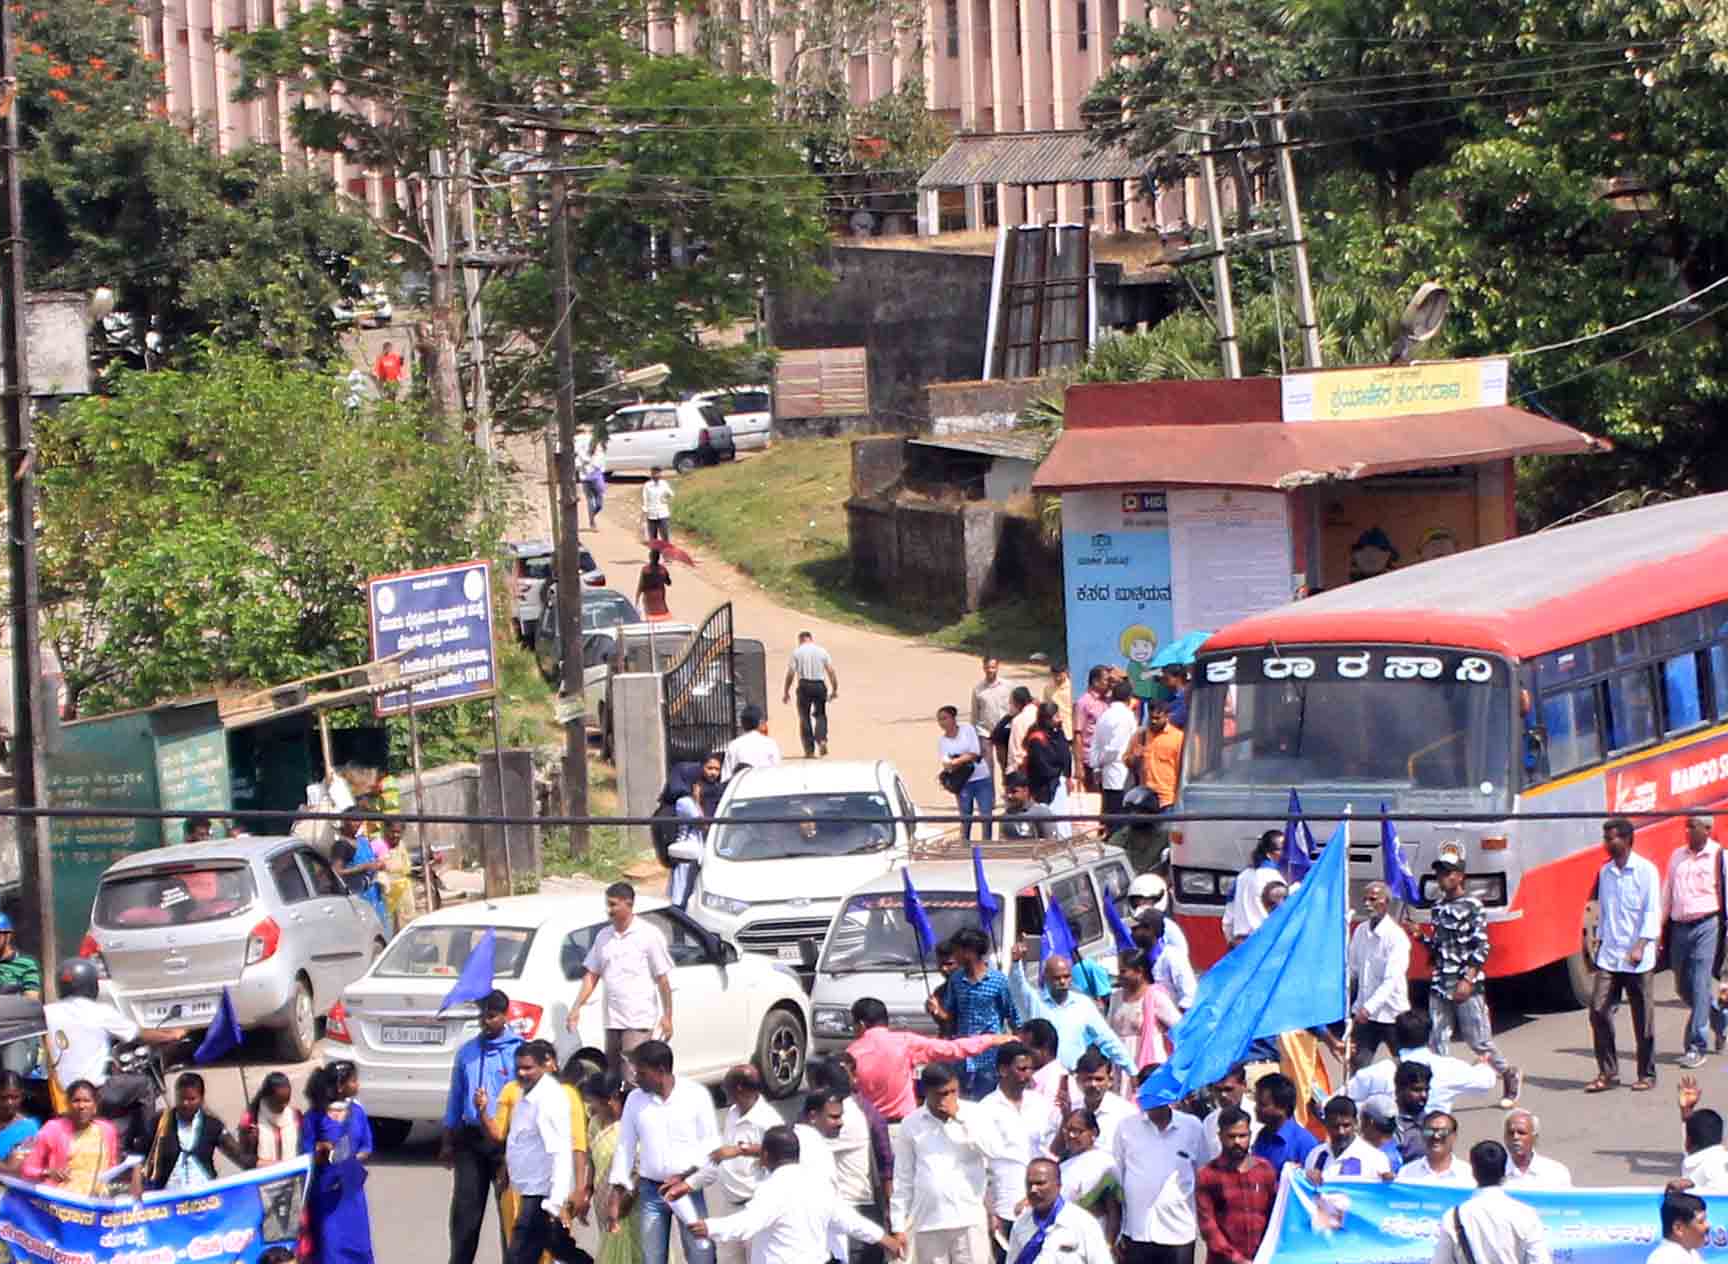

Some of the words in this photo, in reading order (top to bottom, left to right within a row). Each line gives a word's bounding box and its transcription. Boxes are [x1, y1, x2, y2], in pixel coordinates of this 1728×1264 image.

[1206, 656, 1237, 683] ಕ
[1263, 656, 1316, 680] ರಾ
[1336, 651, 1371, 680] ರ
[1383, 655, 1444, 680] ಸಾ
[1456, 657, 1492, 683] ನಿ
[1670, 757, 1719, 796] RAMCO
